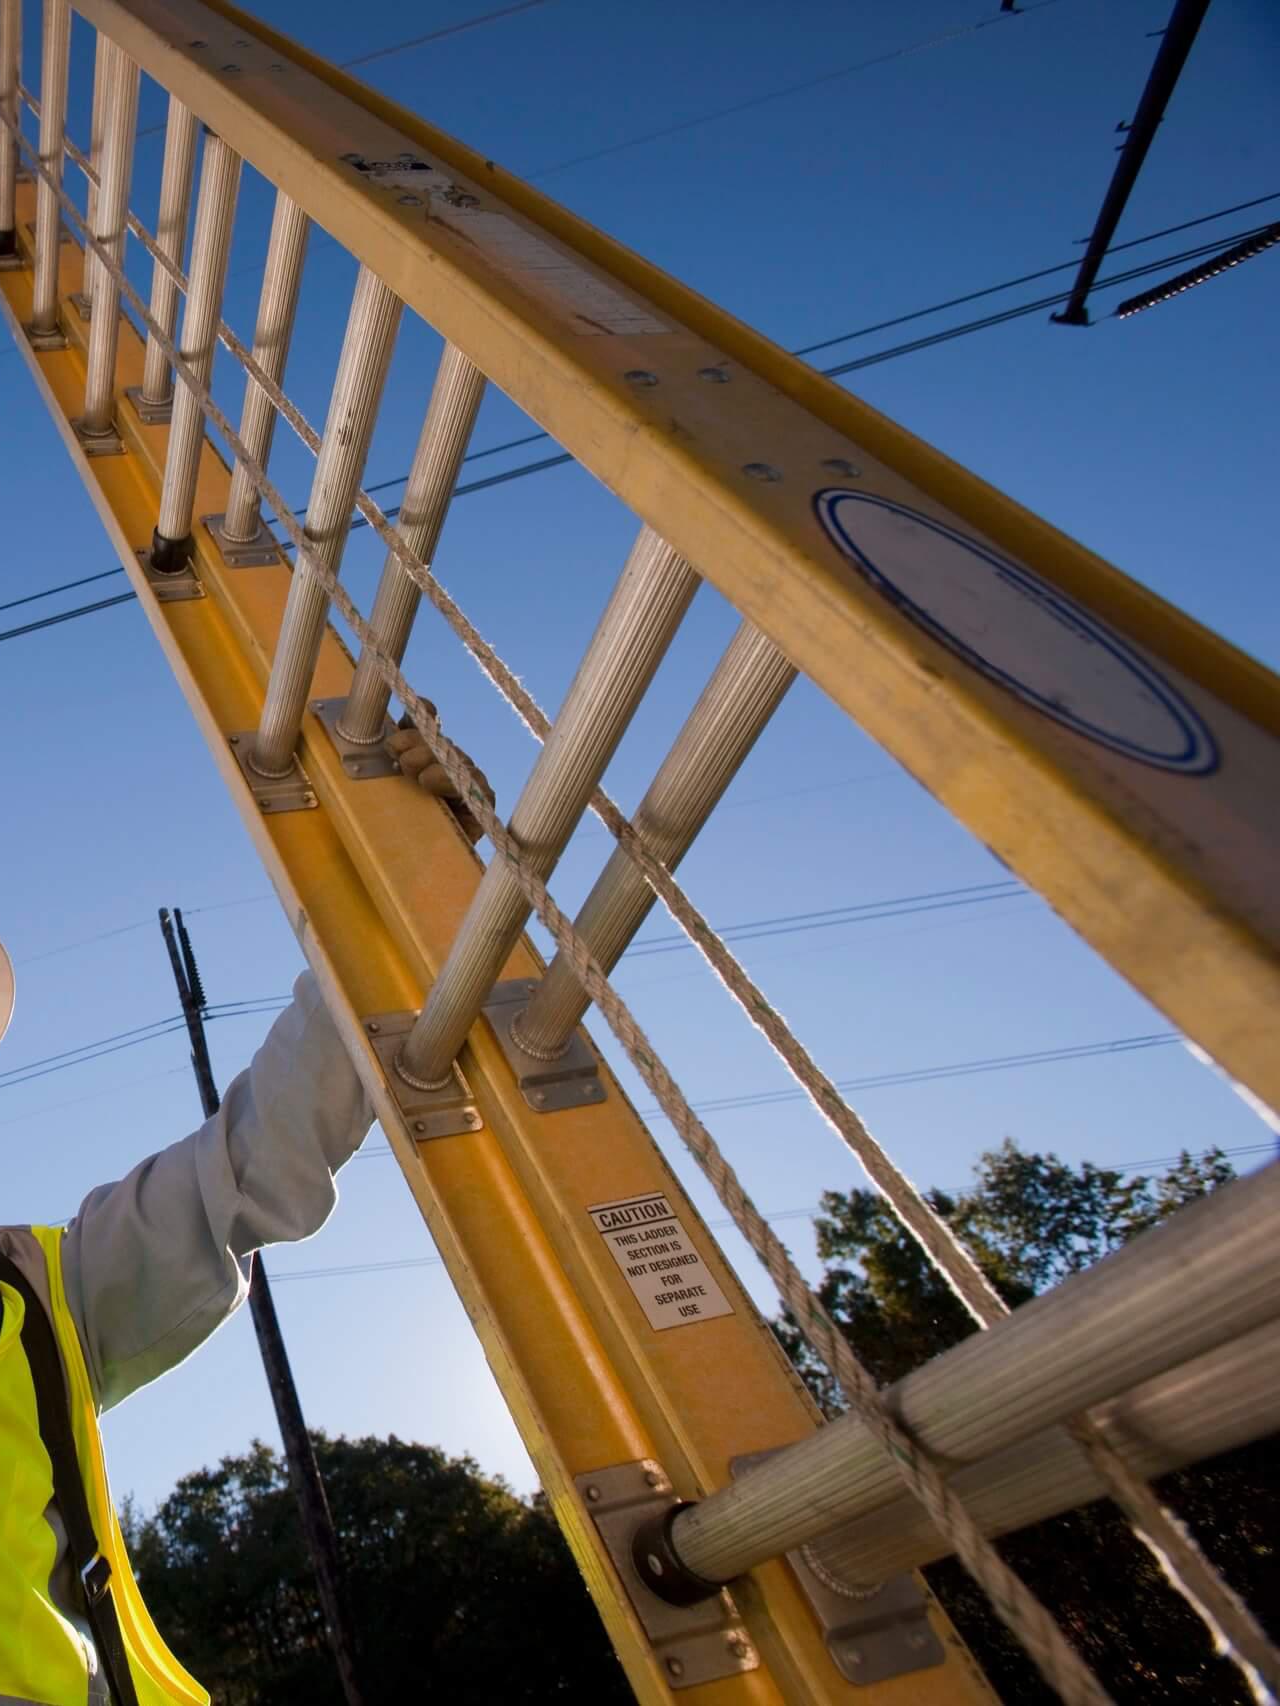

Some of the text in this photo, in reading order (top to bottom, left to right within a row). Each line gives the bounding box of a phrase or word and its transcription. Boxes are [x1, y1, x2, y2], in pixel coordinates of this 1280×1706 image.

[599, 1202, 669, 1228] CAUTION
[613, 1225, 678, 1247] THIS LADDER
[627, 1240, 682, 1261] SECTION IS
[627, 1253, 698, 1278] NOT DESIGNED
[660, 1273, 683, 1287] FOR
[654, 1285, 707, 1305] SEPARATE
[679, 1304, 701, 1317] USE
